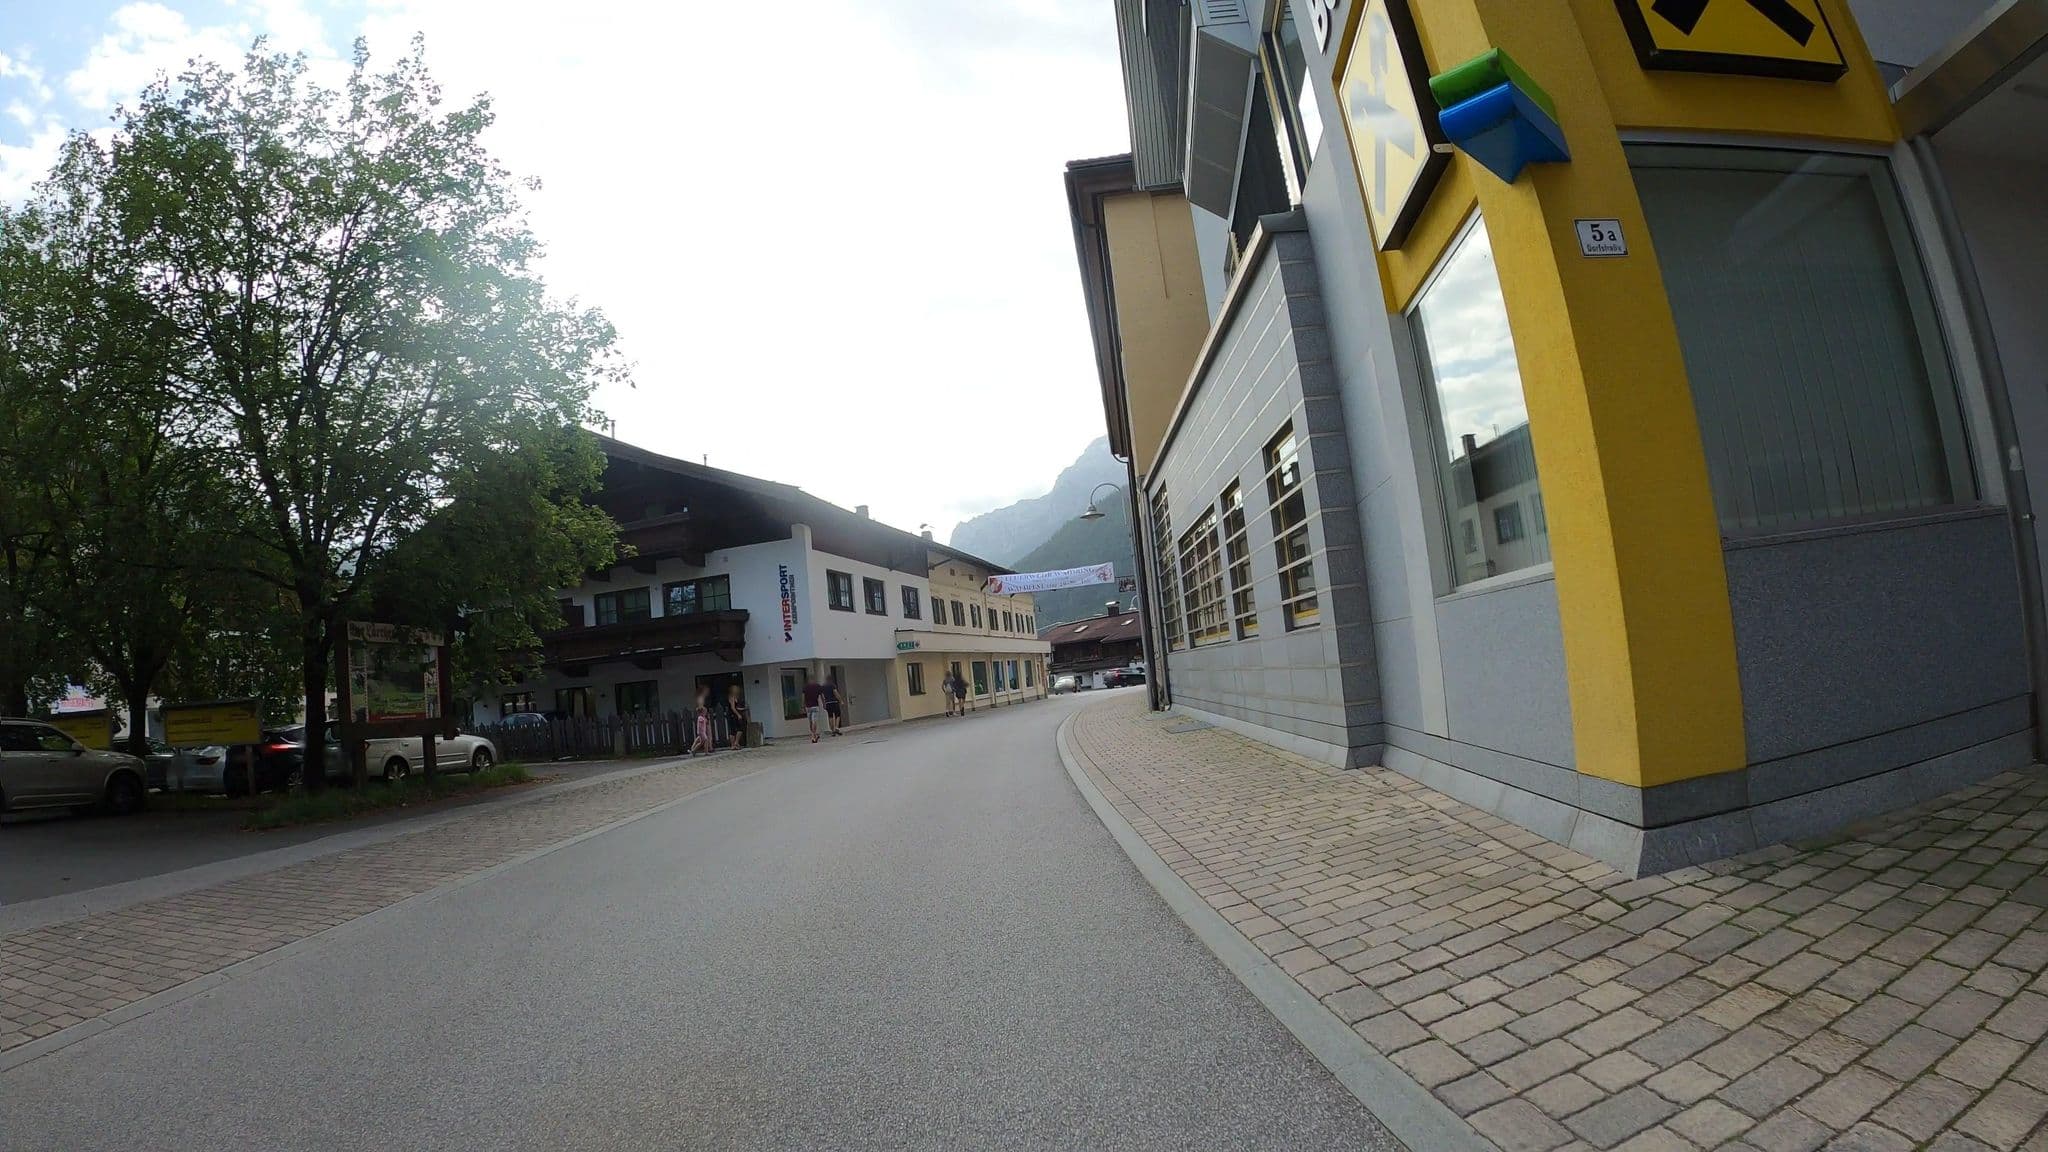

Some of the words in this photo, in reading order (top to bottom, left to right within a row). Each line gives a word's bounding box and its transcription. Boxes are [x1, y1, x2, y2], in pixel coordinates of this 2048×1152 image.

[1591, 223, 1604, 242] 5
[1607, 230, 1617, 241] a
[779, 564, 792, 631] INTERSPORT
